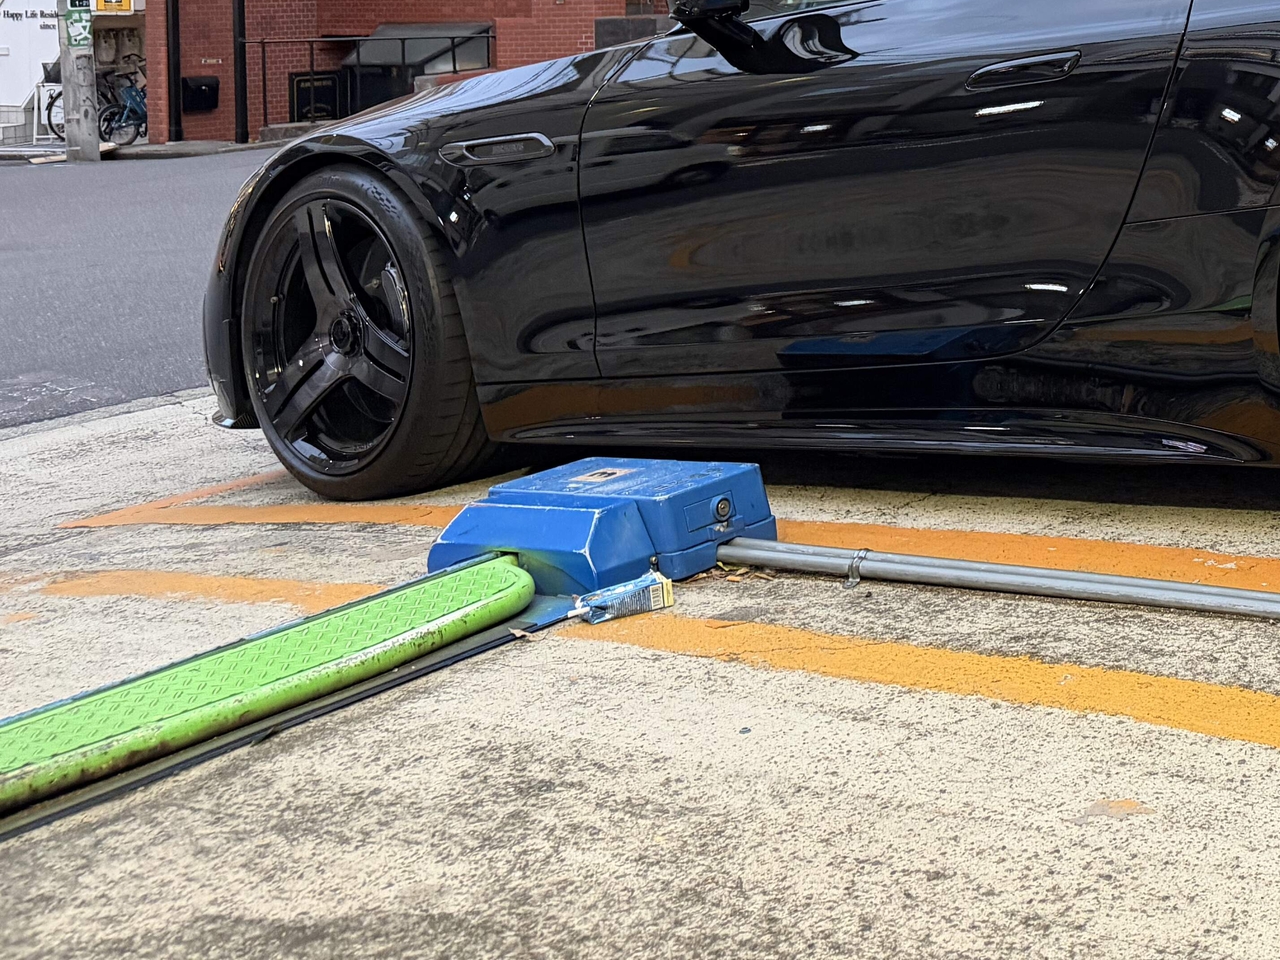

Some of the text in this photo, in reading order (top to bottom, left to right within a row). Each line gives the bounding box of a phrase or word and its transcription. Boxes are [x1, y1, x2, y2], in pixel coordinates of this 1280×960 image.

[3, 10, 23, 21] Happy
[25, 10, 38, 18] Life
[40, 22, 56, 30] since
